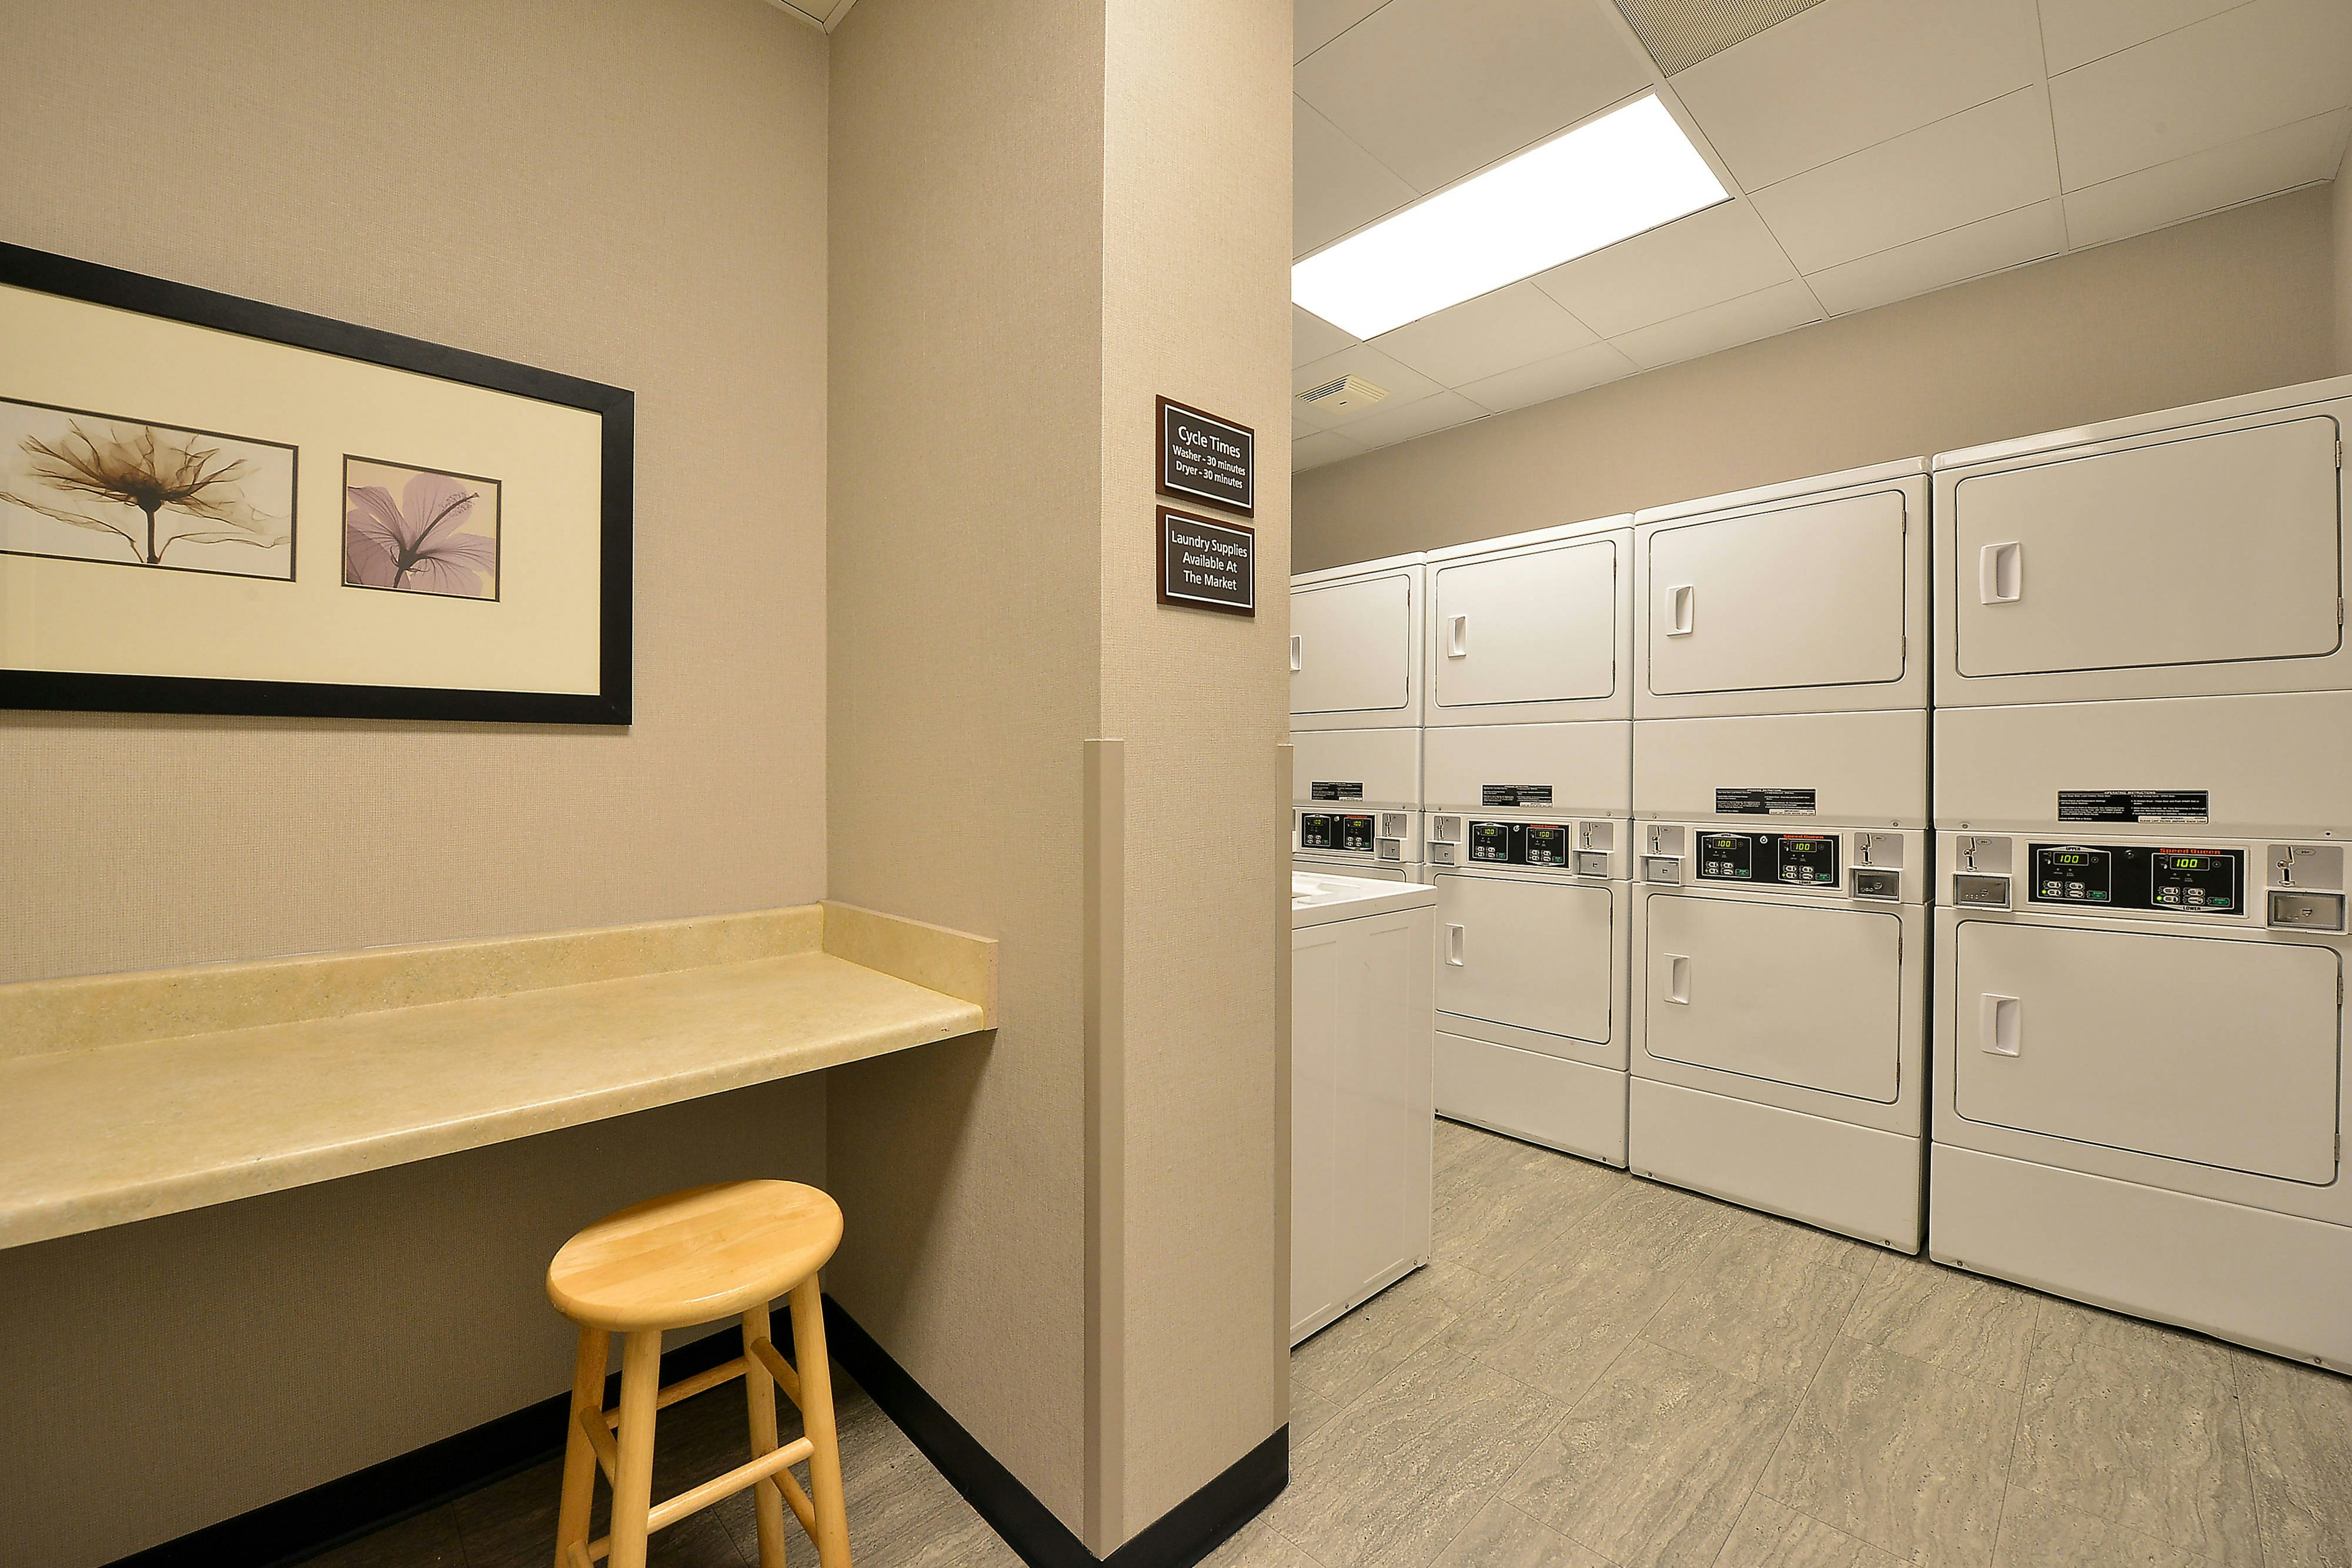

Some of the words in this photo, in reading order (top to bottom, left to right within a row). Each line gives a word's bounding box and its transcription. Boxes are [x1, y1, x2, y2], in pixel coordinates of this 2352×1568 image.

[1178, 426, 1208, 447] Cycle
[1209, 435, 1241, 458] Times
[1172, 444, 1201, 462] Washer
[1207, 455, 1217, 467] 30
[1217, 460, 1246, 476] minutes
[1176, 460, 1198, 476] Dryer
[1203, 469, 1213, 480] 30
[1214, 473, 1243, 489] minutes
[1171, 530, 1210, 552] Laundry
[1211, 539, 1247, 558] Supplies
[1182, 551, 1224, 570] Available
[1226, 560, 1237, 573] At
[1183, 570, 1202, 584] The
[1204, 574, 1237, 591] Market
[2060, 855, 2079, 864] 100
[2176, 858, 2198, 868] 100
